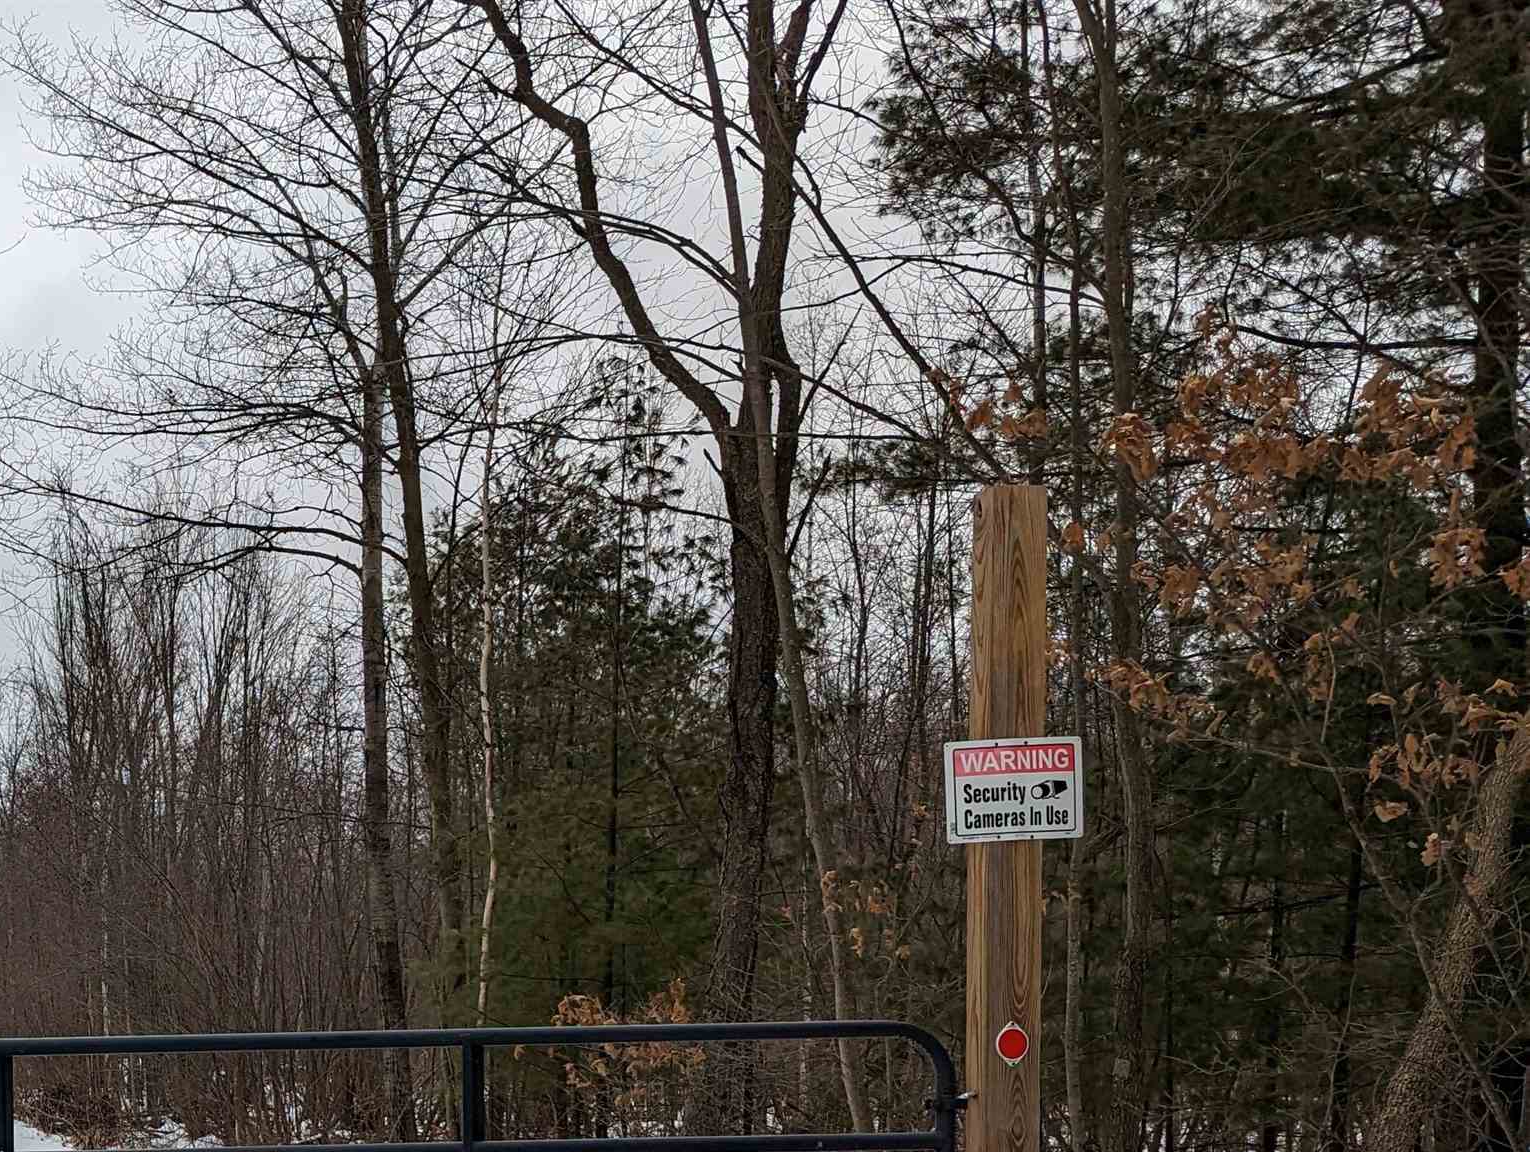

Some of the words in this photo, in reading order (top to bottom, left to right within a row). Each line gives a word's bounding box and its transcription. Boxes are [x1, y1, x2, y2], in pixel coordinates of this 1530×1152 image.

[960, 748, 1070, 773] WARNING
[963, 781, 1026, 805] Security
[964, 809, 1026, 830] Cameras
[1030, 806, 1042, 826] In
[1046, 805, 1069, 825] Use
